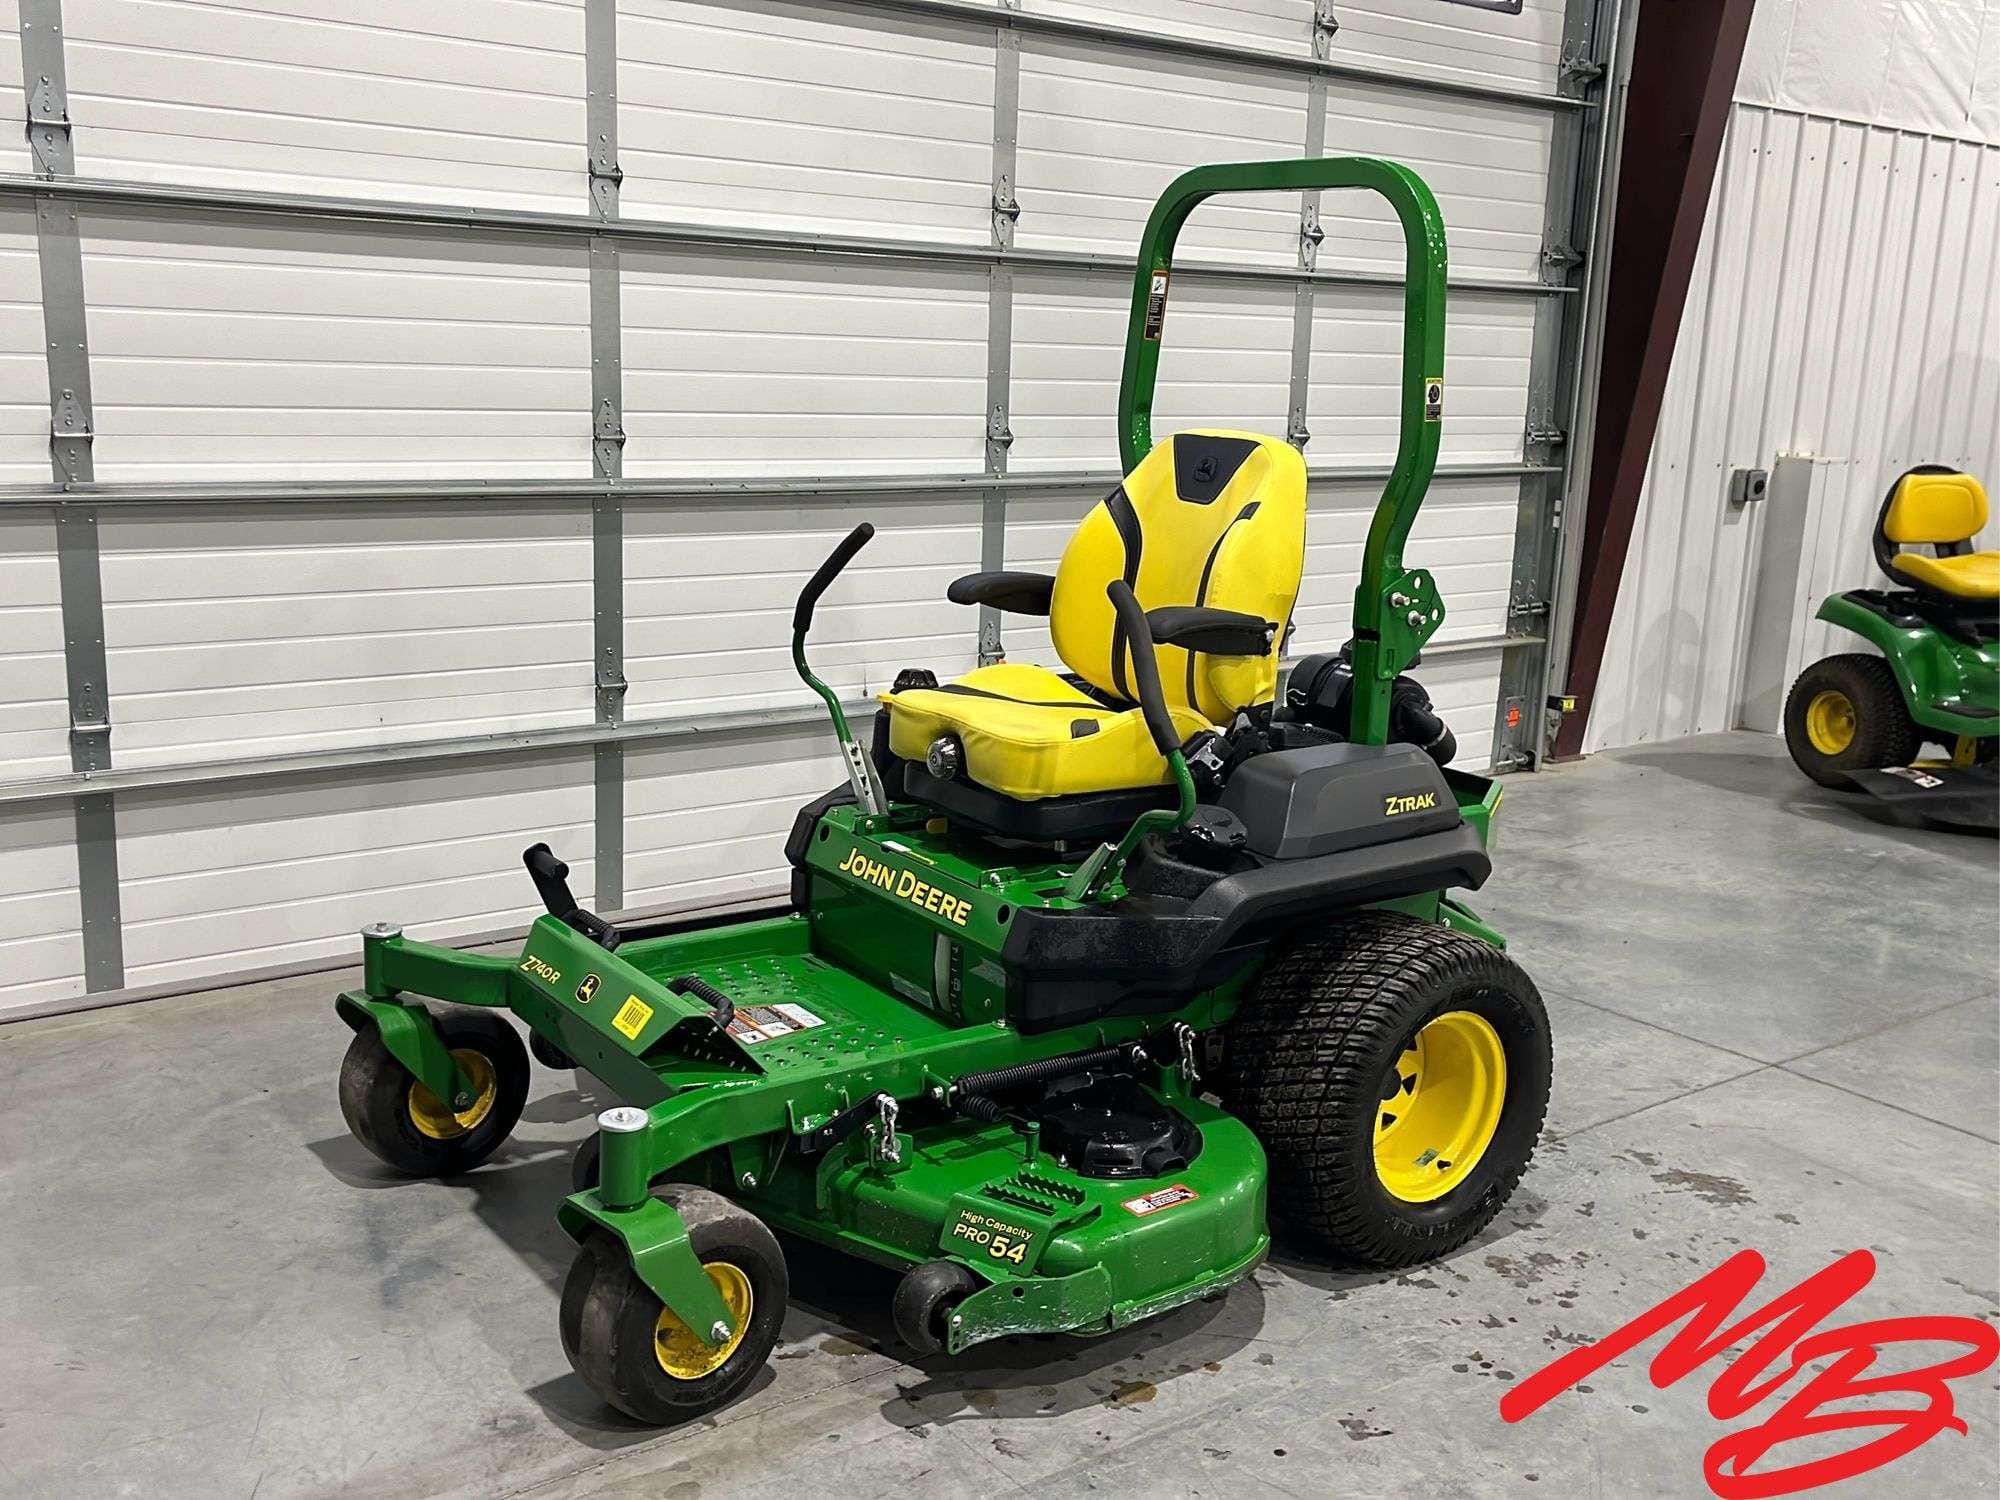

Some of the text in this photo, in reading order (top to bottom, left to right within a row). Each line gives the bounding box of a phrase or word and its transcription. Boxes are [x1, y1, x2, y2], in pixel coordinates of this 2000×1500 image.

[1385, 792, 1436, 816] ZTRAK
[839, 847, 973, 926] JOHN DEERE
[520, 955, 561, 985] Z740R
[960, 1209, 1033, 1241] High Capacity
[953, 1223, 1028, 1265] PRO 54
